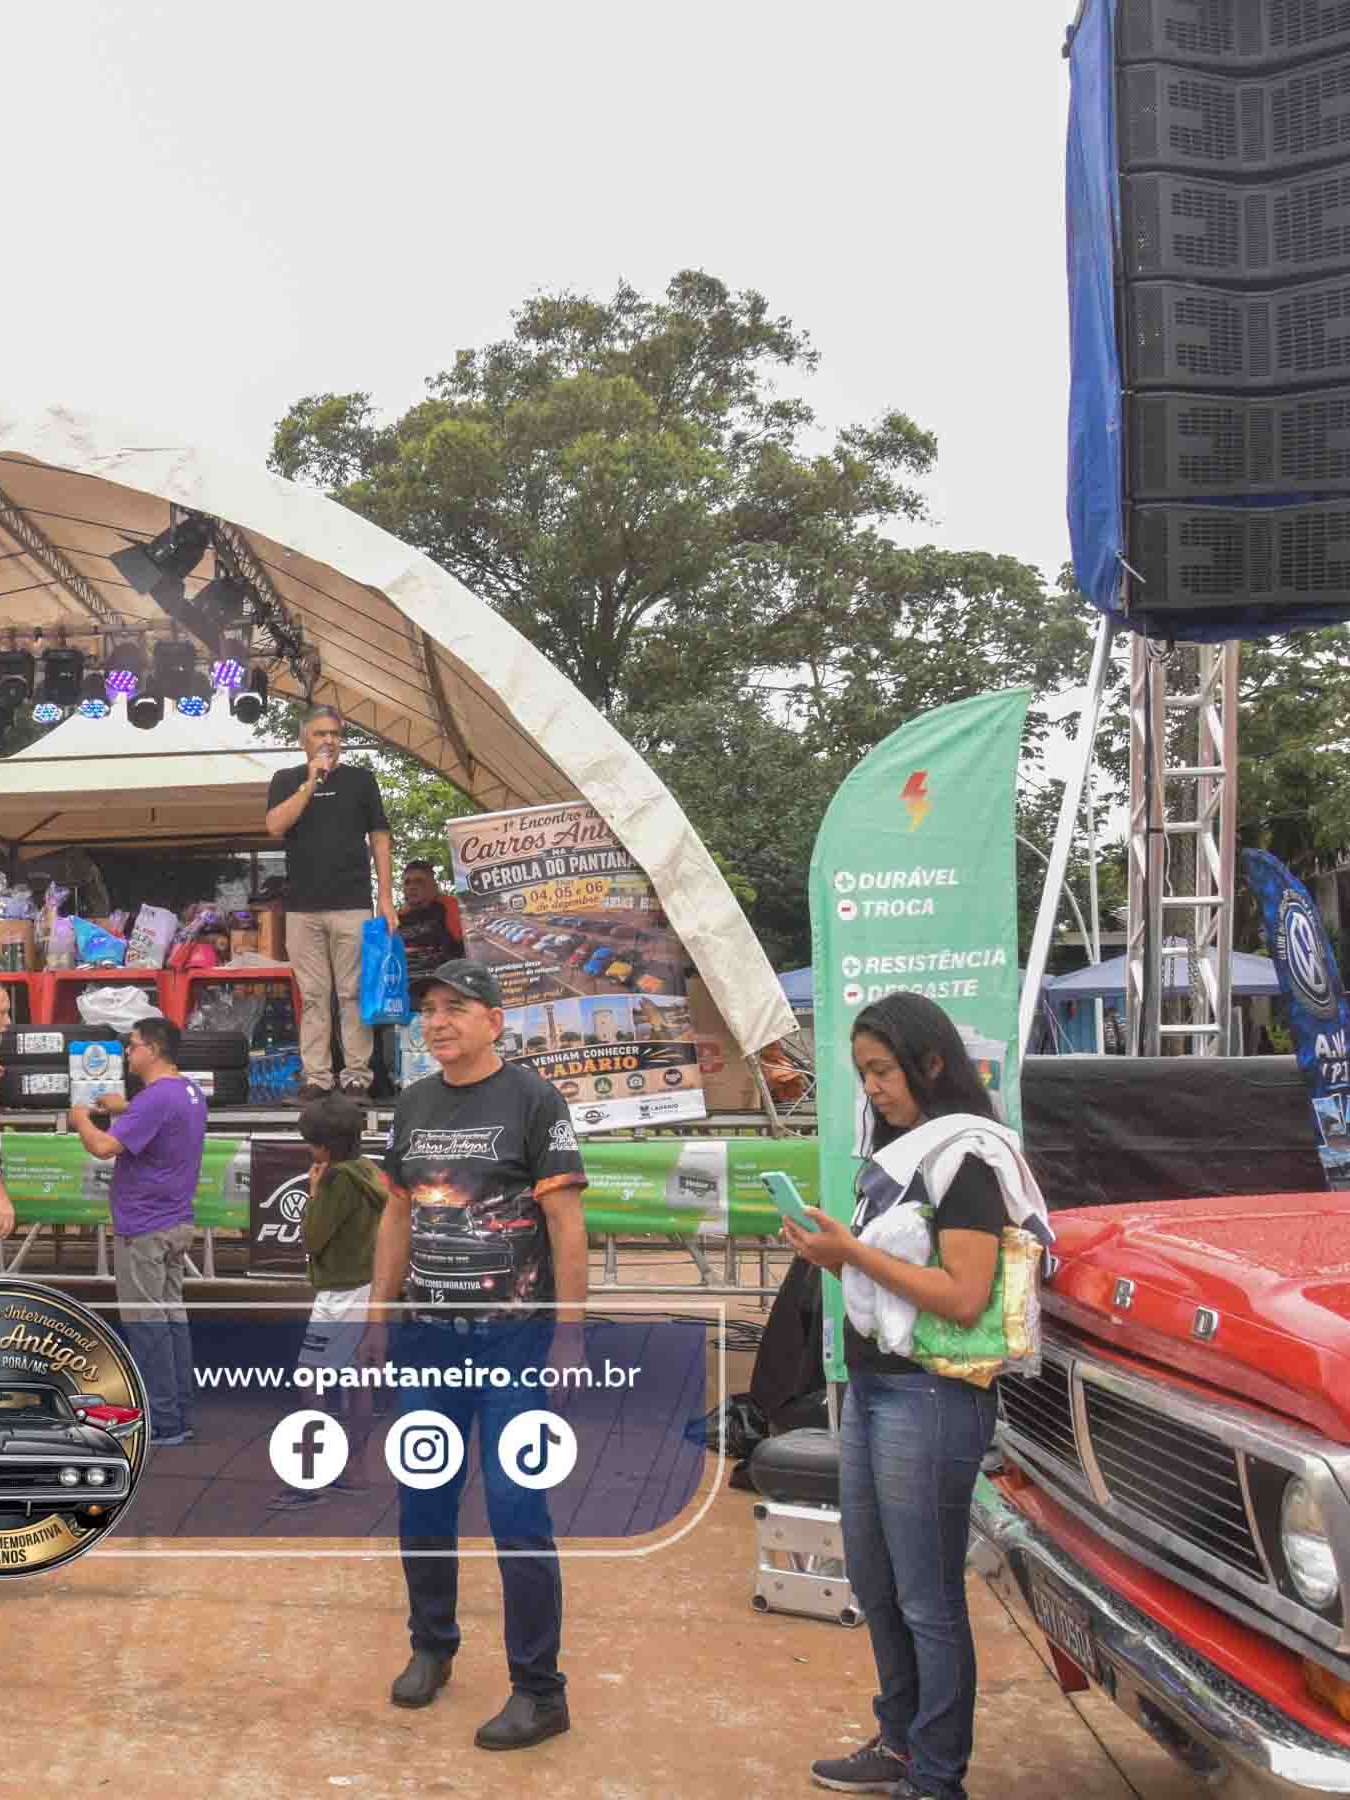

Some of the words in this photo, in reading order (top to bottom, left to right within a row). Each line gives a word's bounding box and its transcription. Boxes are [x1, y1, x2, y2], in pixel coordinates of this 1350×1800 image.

[520, 811, 581, 831] Encontro
[460, 832, 546, 864] Carros
[552, 848, 567, 856] NA
[481, 860, 542, 890] PÉROLA
[545, 857, 566, 875] DO
[858, 865, 960, 889] DURÁVEL
[554, 887, 572, 898] 05
[586, 881, 603, 895] 06
[861, 897, 936, 917] TROCA
[864, 948, 1007, 974] RESISTÊNCIA
[532, 1051, 580, 1067] VENHAM
[584, 1045, 640, 1059] CONHECER
[257, 1223, 302, 1243] FU
